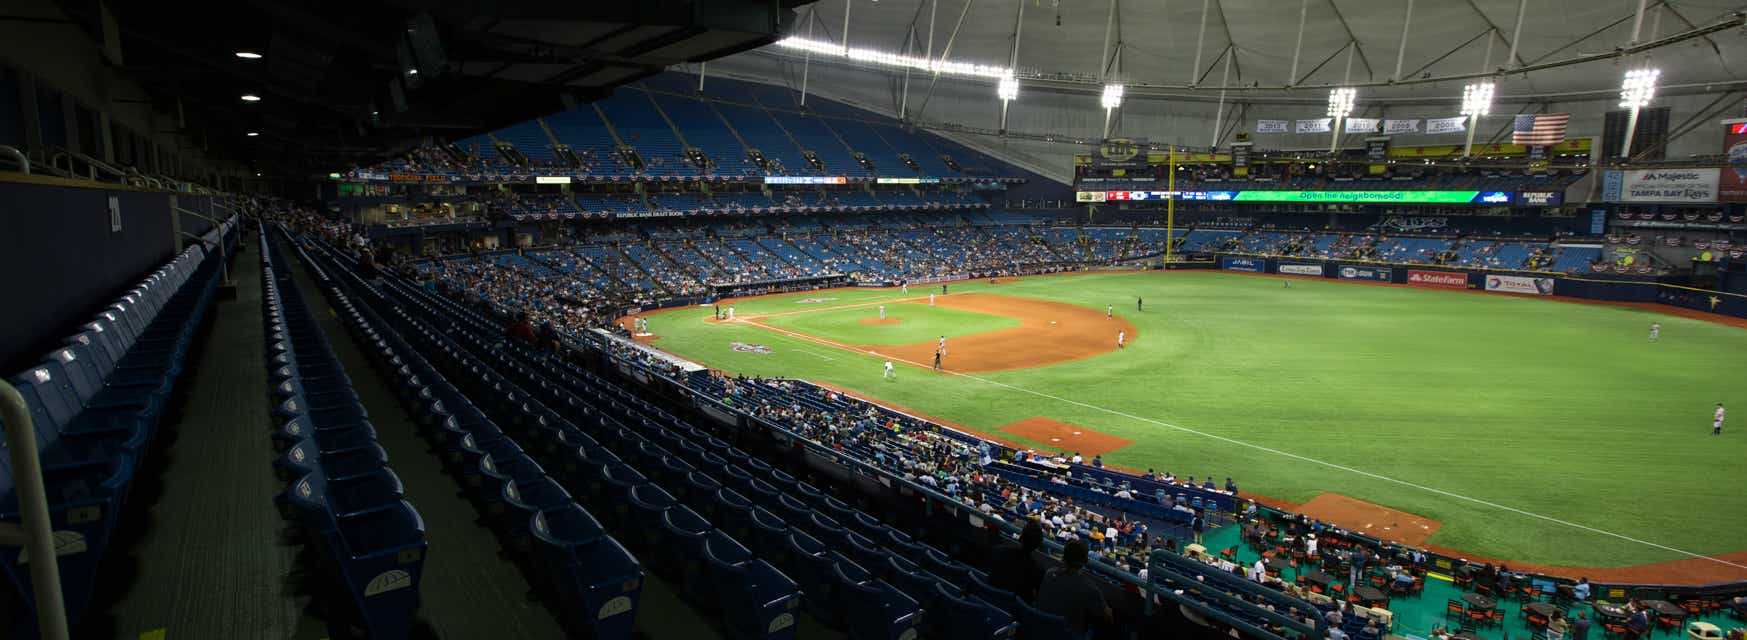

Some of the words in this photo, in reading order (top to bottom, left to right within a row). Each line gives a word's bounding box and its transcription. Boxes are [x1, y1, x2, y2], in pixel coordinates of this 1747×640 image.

[1659, 172, 1699, 181] Majestic
[1684, 188, 1710, 200] Rays
[1503, 280, 1535, 289] TOTAL
